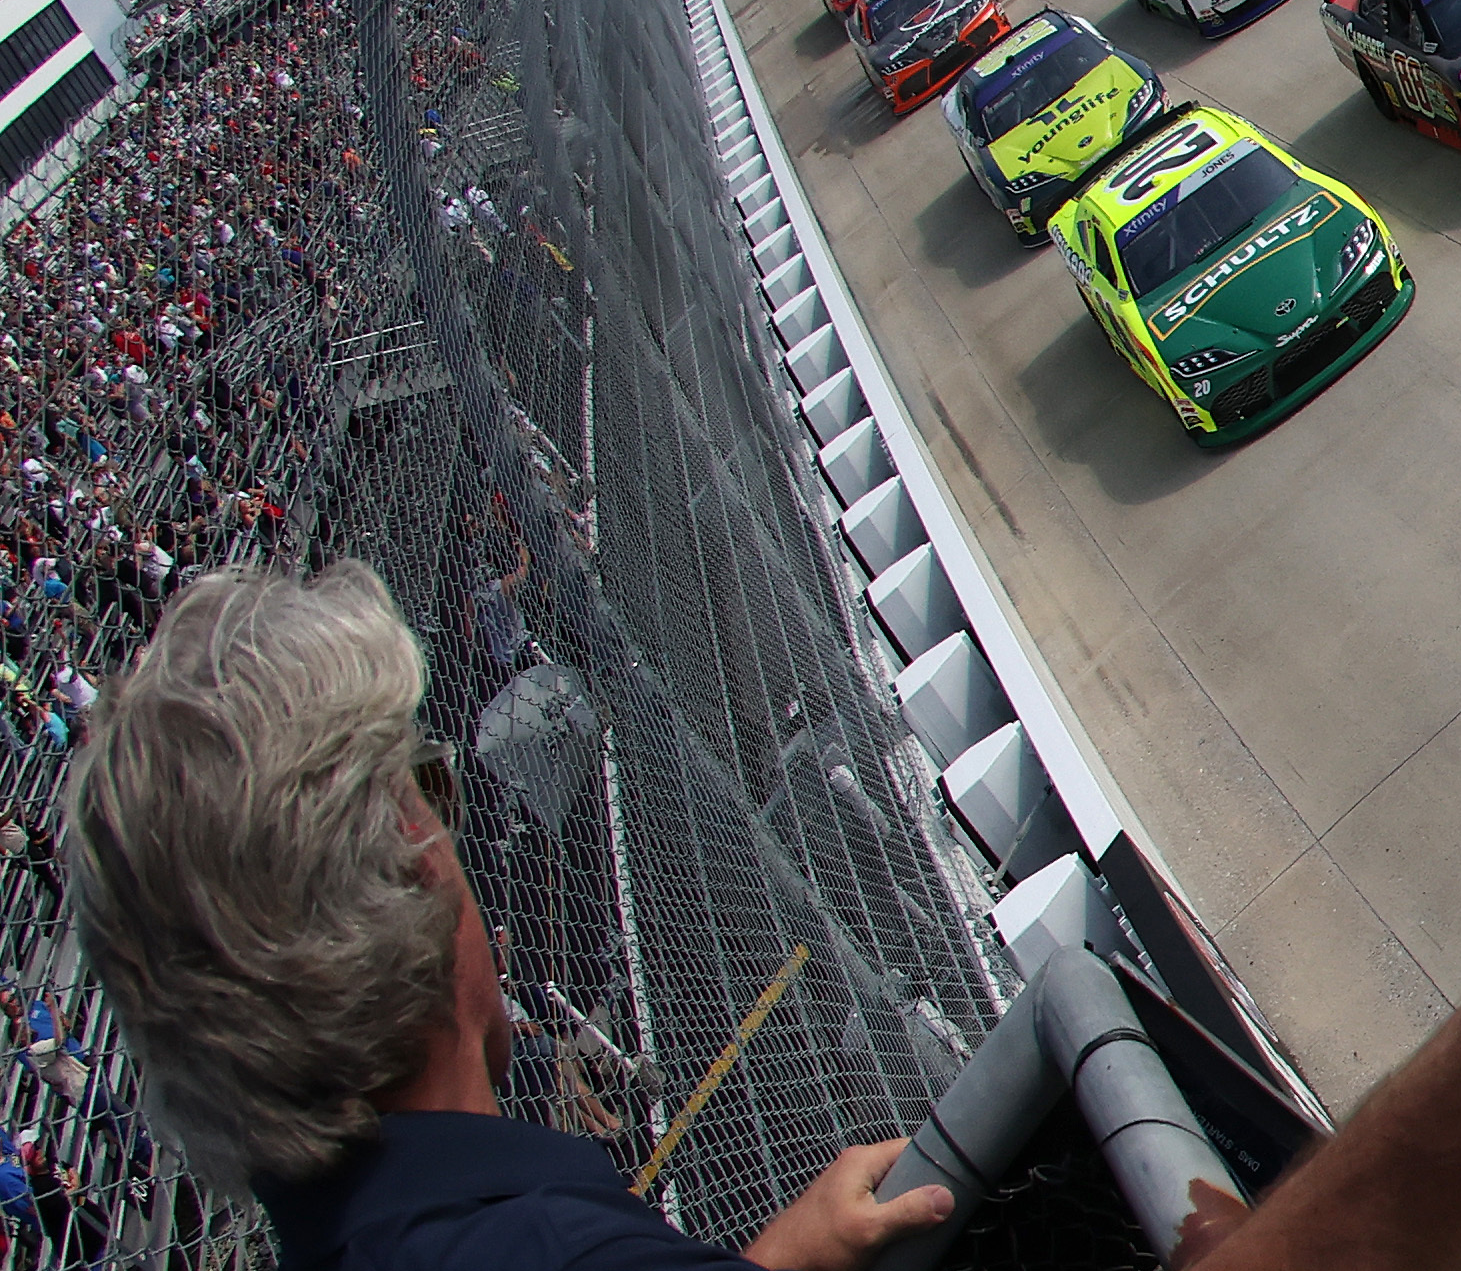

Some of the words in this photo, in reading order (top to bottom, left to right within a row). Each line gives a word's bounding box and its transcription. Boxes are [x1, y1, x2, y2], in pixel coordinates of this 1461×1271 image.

[1010, 50, 1046, 79] xfinity
[1017, 86, 1121, 164] younglife
[1199, 151, 1237, 180] JONES
[1122, 197, 1169, 237] xfinity
[1163, 201, 1321, 322] SCHULTZ
[1274, 313, 1320, 349] Supra
[1193, 379, 1211, 398] 20
